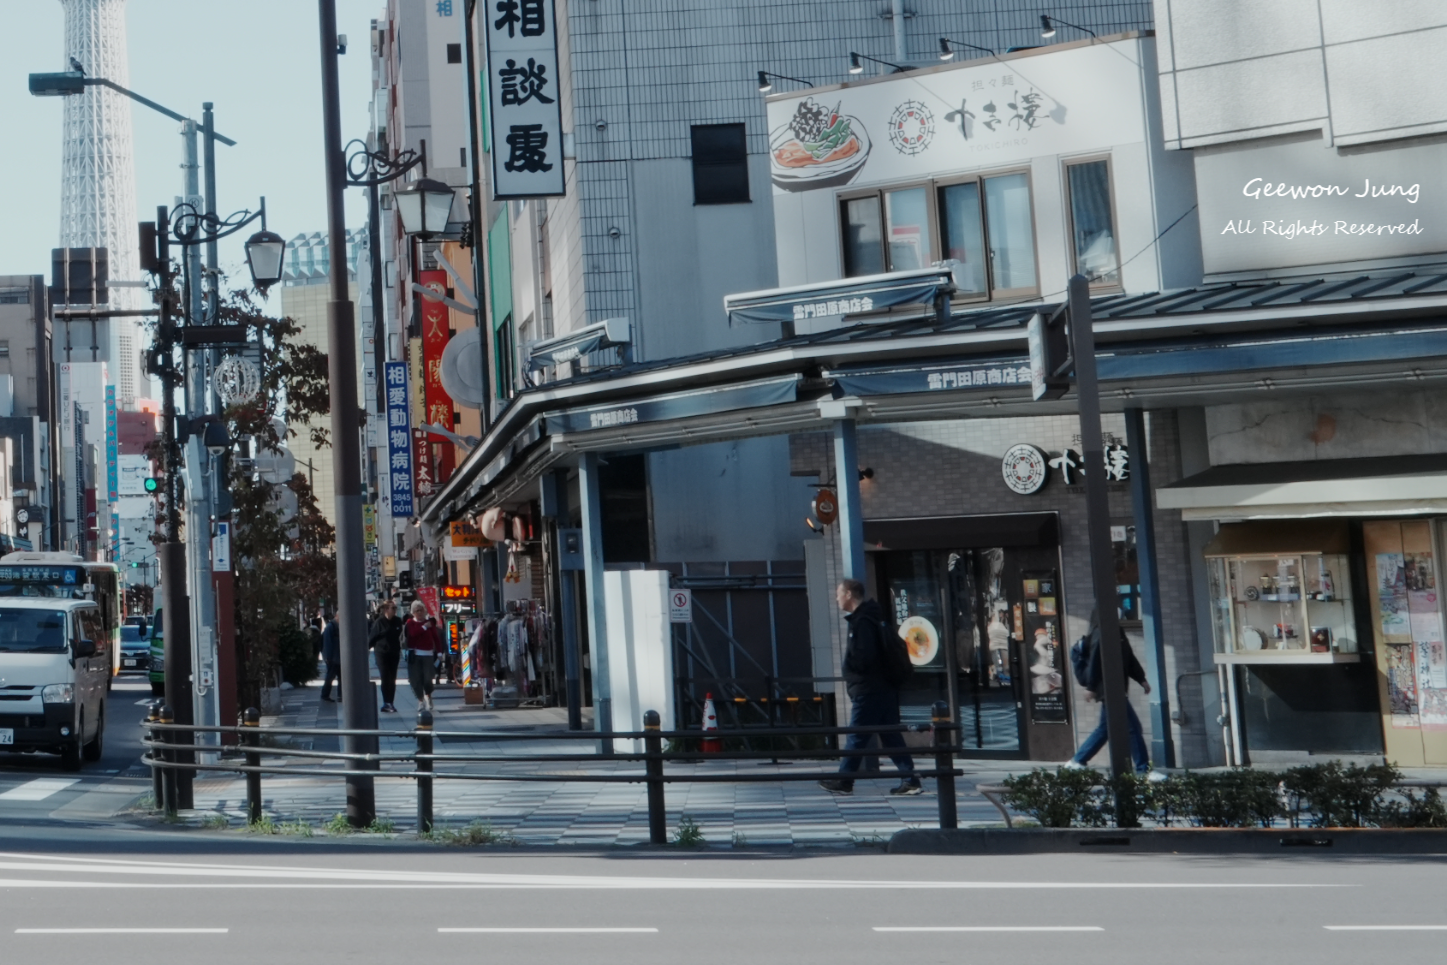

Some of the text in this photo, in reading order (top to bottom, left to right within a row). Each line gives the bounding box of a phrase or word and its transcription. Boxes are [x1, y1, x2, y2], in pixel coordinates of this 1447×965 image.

[436, 0, 452, 17] 相
[793, 297, 873, 319] 雷門田原商店会
[927, 366, 1032, 389] 雷門田原商店会
[388, 366, 410, 491] 相愛動物病院
[393, 494, 411, 502] 3845
[393, 505, 412, 513] 0011
[444, 586, 470, 597] セット
[445, 603, 471, 613] フリー
